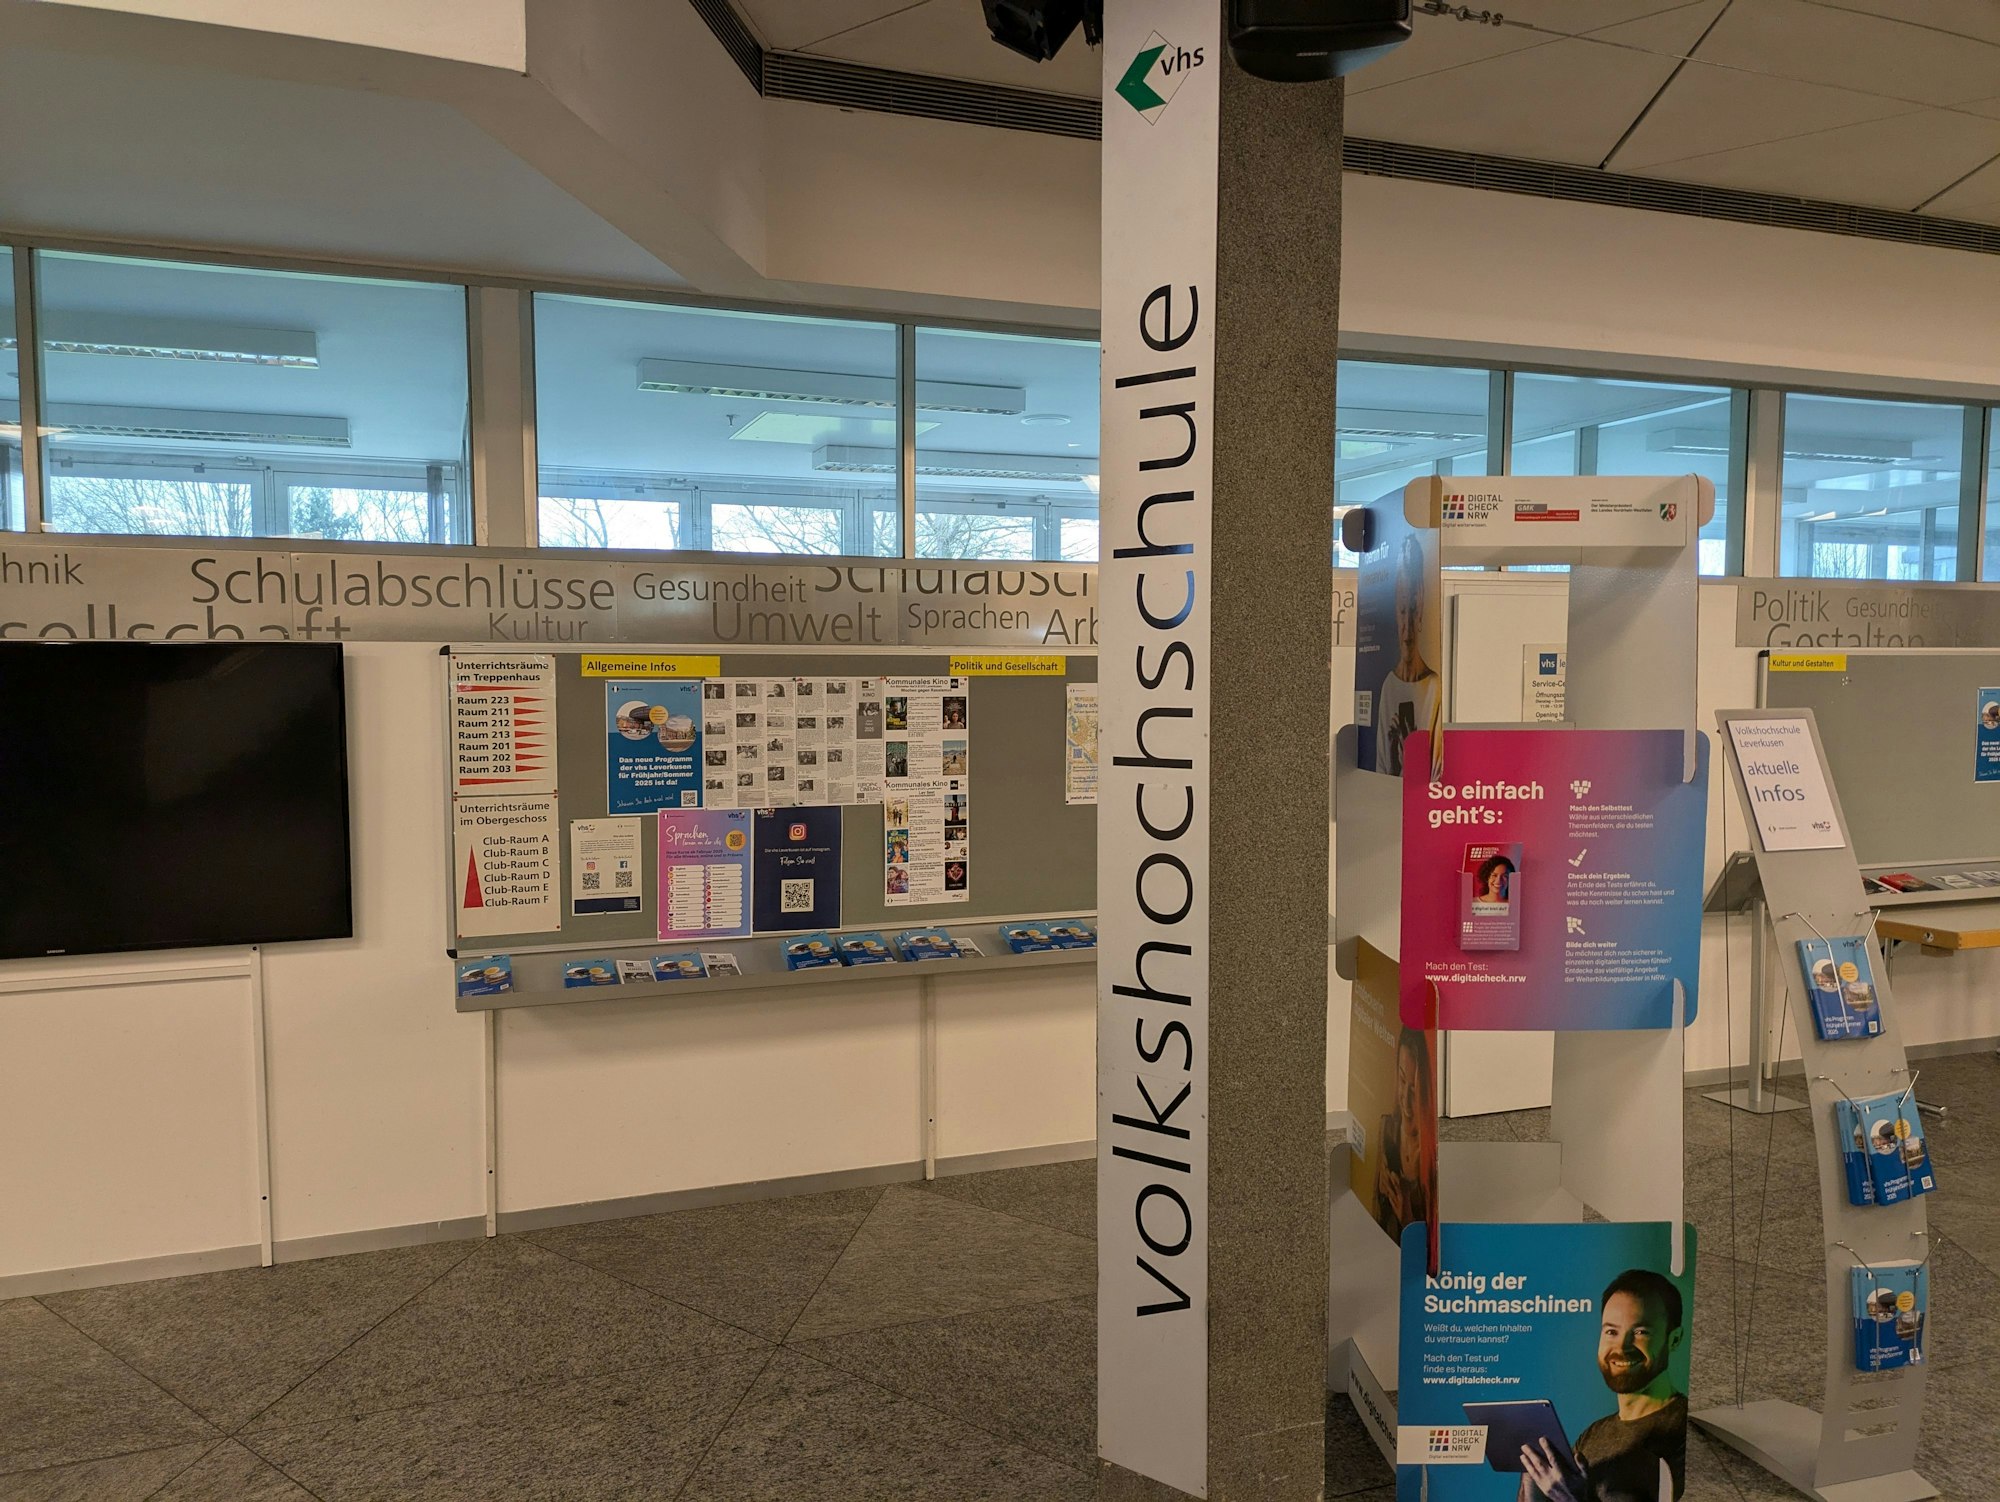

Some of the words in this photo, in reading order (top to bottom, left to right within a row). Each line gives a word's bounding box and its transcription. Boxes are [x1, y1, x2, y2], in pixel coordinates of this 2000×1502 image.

[1161, 47, 1204, 76] vhs
[1468, 494, 1503, 502] DIGITAL
[2, 553, 84, 585] hnik
[191, 557, 615, 610] Schulabschlüsse
[633, 573, 807, 603] Gesundheit
[1753, 590, 1830, 622] Politik
[712, 601, 882, 643] Umwelt
[908, 603, 1029, 635] Sprachen
[489, 612, 588, 641] Kultur
[456, 662, 549, 670] Unterrichtsräume
[586, 661, 647, 672] Allgemeine
[650, 662, 676, 672] Infos
[954, 662, 983, 670] Politik
[986, 662, 1002, 670] und
[1004, 662, 1058, 671] Gesellschaft
[1541, 659, 1556, 668] vhs
[1772, 659, 1790, 667] Kultur
[1792, 659, 1804, 667] und
[1805, 659, 1834, 668] Gestalten
[474, 673, 540, 682] Treppenhaus
[490, 696, 510, 704] 223
[458, 708, 488, 716] Raum
[491, 708, 510, 716] 211
[458, 720, 488, 728] Raum
[1736, 725, 1800, 735] Volkshochschule
[492, 742, 510, 750] 201
[1740, 738, 1784, 748] Leverkusen
[459, 754, 489, 762] Raum
[460, 766, 490, 774] Raum
[1748, 760, 1800, 776] aktuelle
[1428, 781, 1456, 800] So
[1462, 780, 1544, 800] einfach
[1754, 784, 1805, 802] Infos
[1112, 284, 1198, 1316] volkshochschule
[460, 802, 550, 814] Unterrichtsräume
[460, 818, 473, 826] im
[476, 815, 547, 826] Obergeschoss
[483, 836, 538, 846] Club-Raum
[542, 834, 550, 842] A
[666, 824, 708, 846] Sprachen
[484, 848, 539, 858] Club-Raum
[484, 860, 539, 870] Club-Raum
[484, 872, 540, 882] Club-Raum
[1603, 872, 1630, 880] Ergebnis
[484, 885, 540, 894] Club-Raum
[485, 897, 540, 907] Club-Raum
[1426, 962, 1448, 970] Mach
[1450, 962, 1466, 970] den
[1468, 962, 1489, 970] Test:
[1595, 958, 1620, 966] digitalen
[1425, 973, 1526, 984] www.digitalcheck.nrw
[1374, 1018, 1396, 1048] Welten
[1425, 1271, 1486, 1294] König
[1491, 1272, 1528, 1290] der
[1424, 1294, 1592, 1314] Suchmaschinen
[1424, 1324, 1449, 1332] Weißt
[1450, 1324, 1462, 1333] du,
[1464, 1324, 1498, 1332] welchen
[1500, 1324, 1532, 1332] Inhalten
[1424, 1335, 1436, 1344] du
[1437, 1336, 1476, 1344] vertrauen
[1478, 1334, 1510, 1344] kannst?
[1424, 1354, 1446, 1362] Mach
[1447, 1354, 1462, 1362] den
[1464, 1354, 1482, 1362] Test
[1484, 1354, 1499, 1362] und
[1424, 1365, 1444, 1373] finde
[1457, 1365, 1488, 1373] heraus:
[1424, 1376, 1520, 1386] www.digitalcheck.nrw
